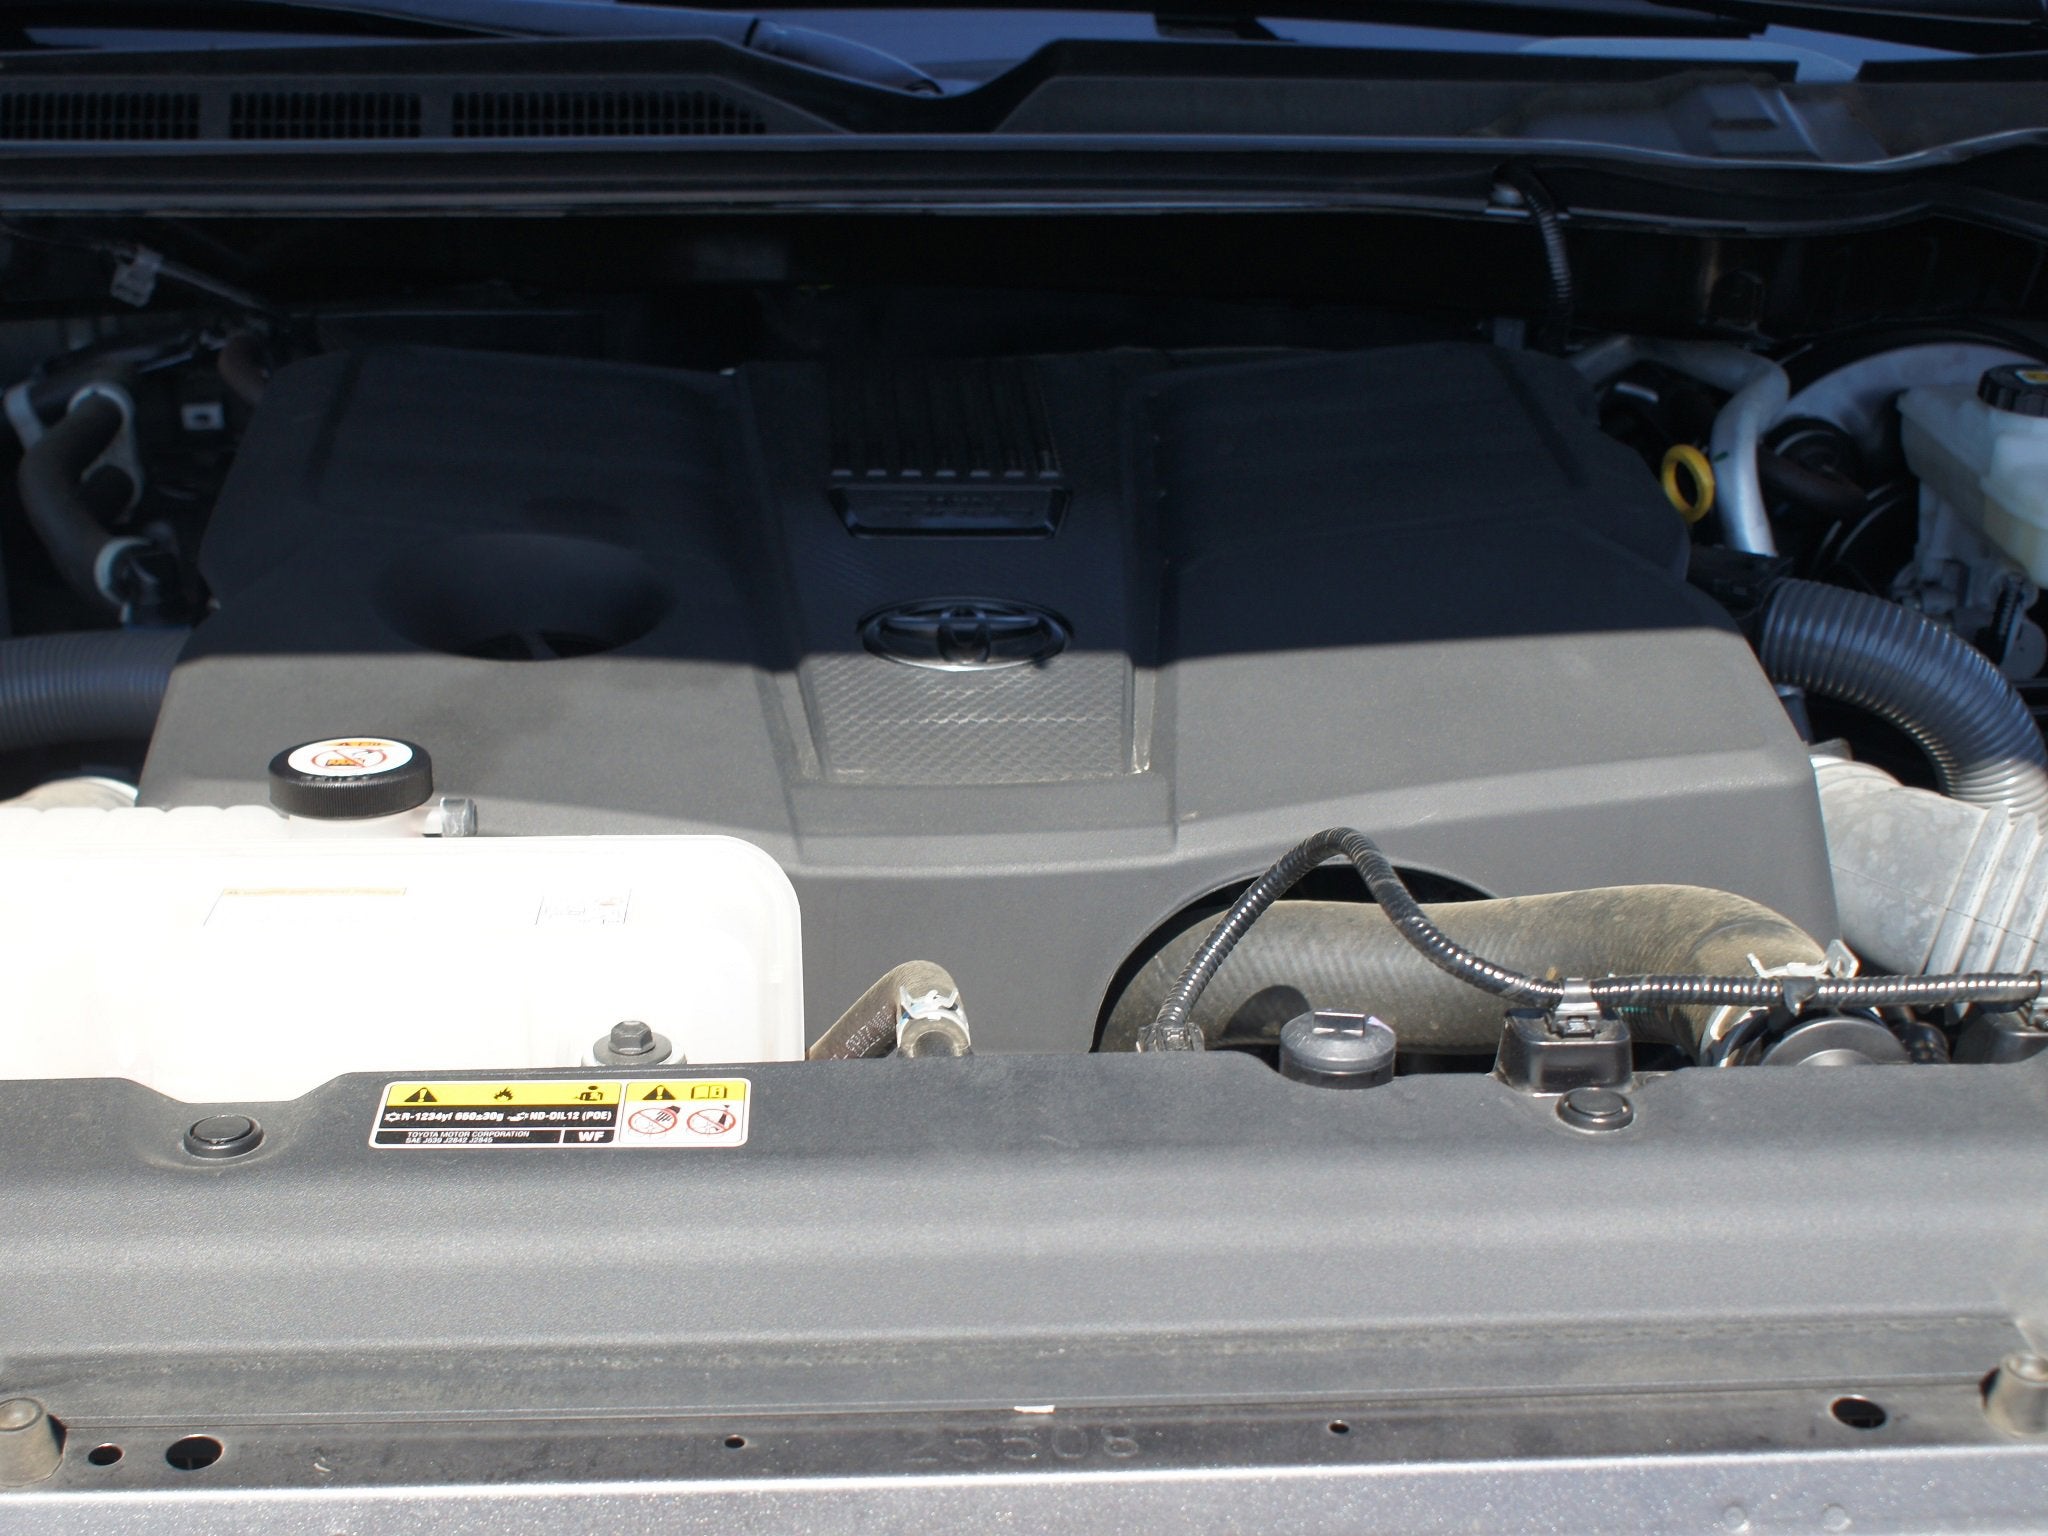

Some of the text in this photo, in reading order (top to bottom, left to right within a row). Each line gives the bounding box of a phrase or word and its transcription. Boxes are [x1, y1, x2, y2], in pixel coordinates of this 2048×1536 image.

[581, 1110, 612, 1121] (POE)
[471, 1130, 530, 1138] CORPORATION
[577, 1131, 605, 1142] WF
